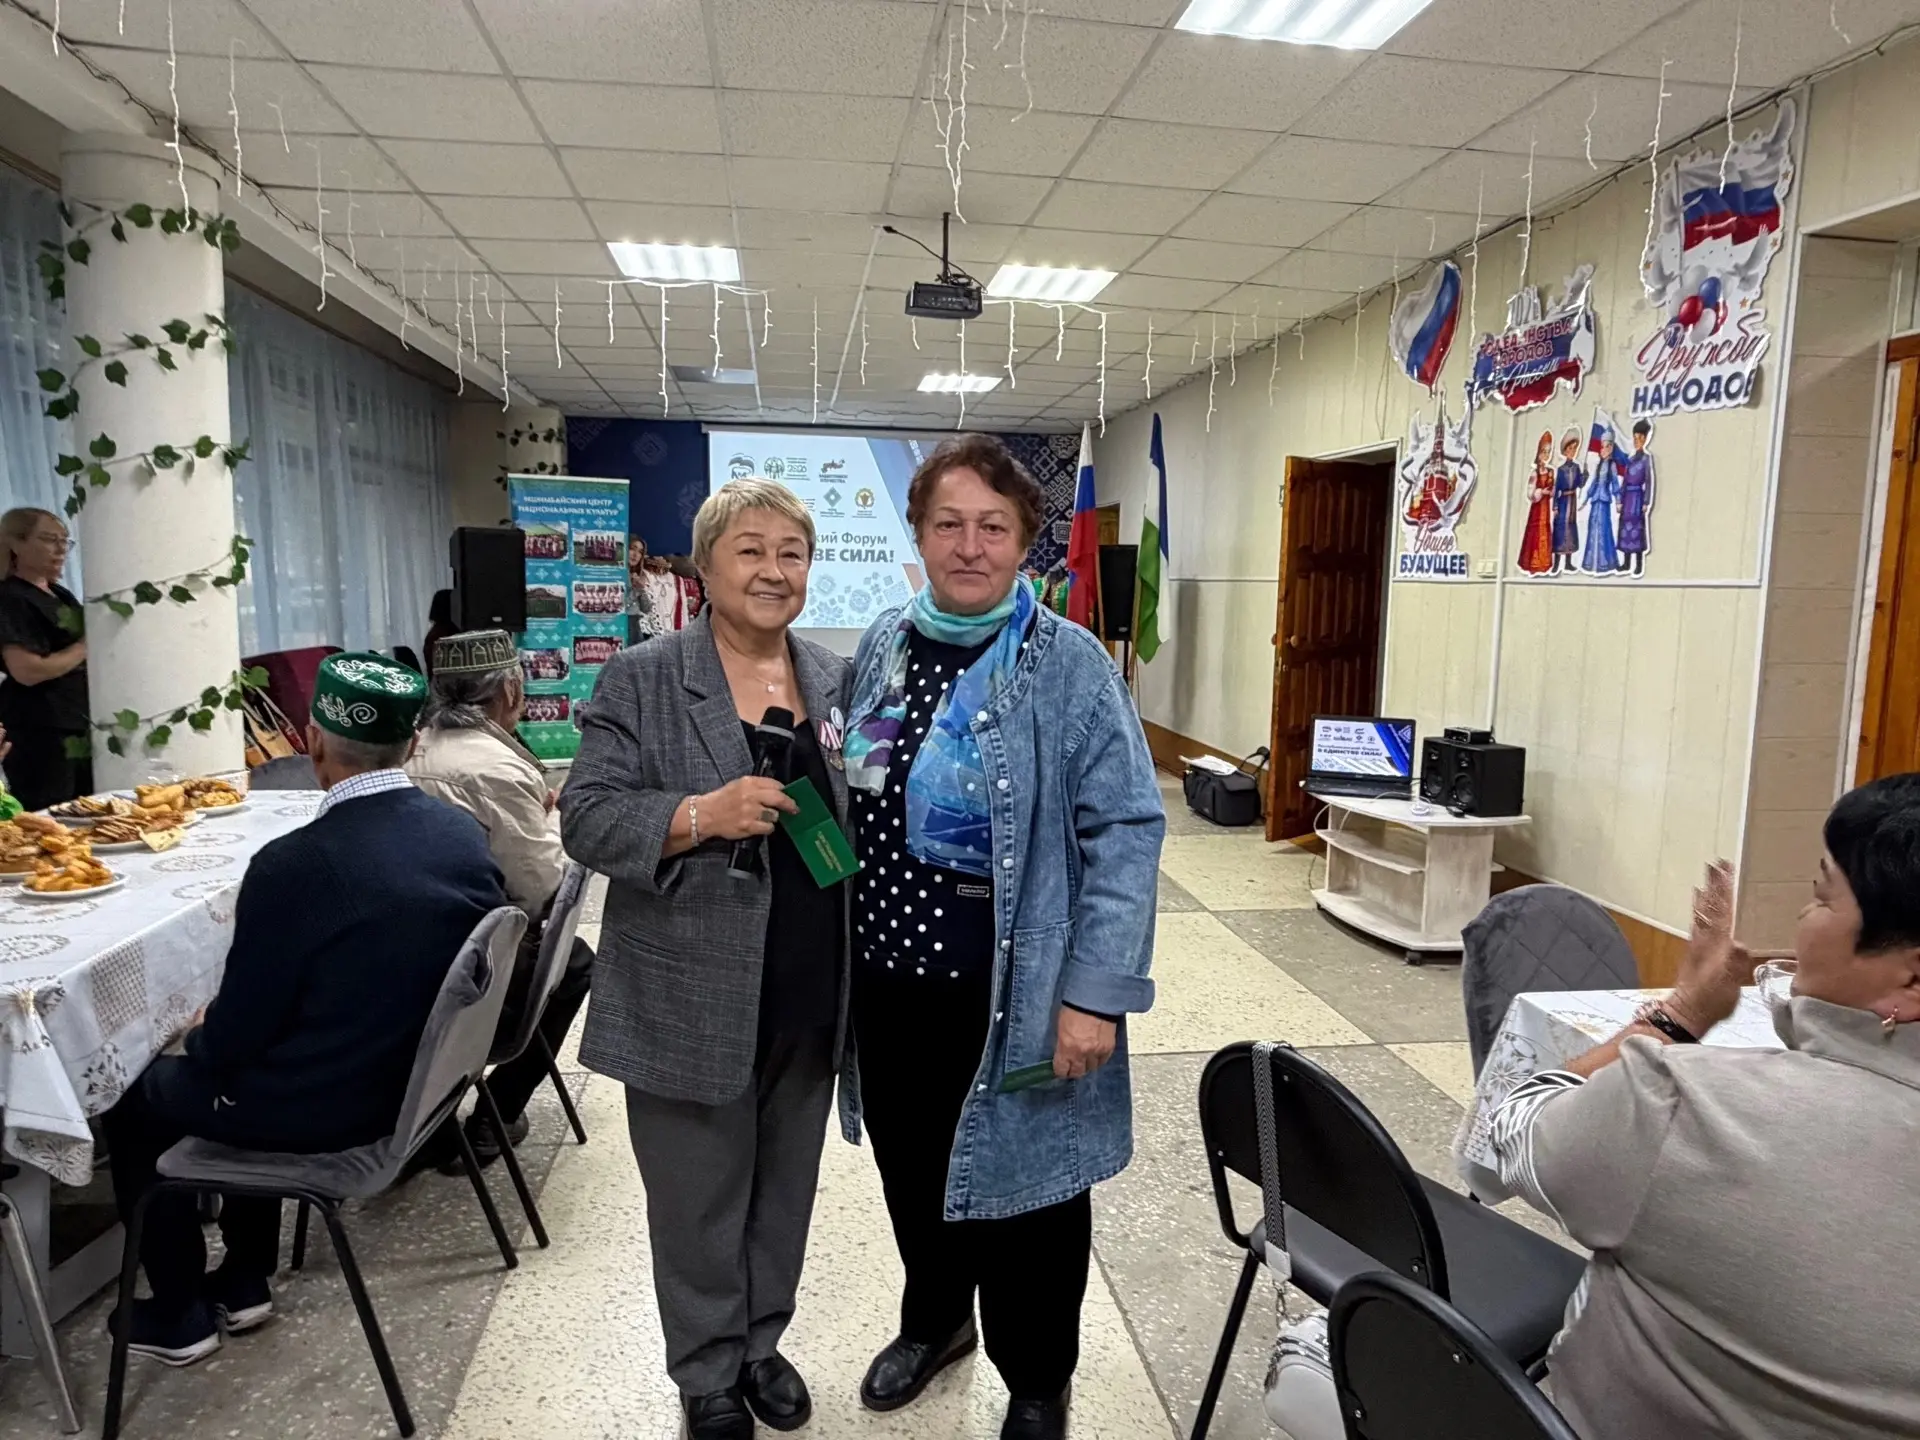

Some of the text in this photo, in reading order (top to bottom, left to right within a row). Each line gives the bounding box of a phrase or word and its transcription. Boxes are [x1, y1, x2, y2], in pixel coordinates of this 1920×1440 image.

[841, 532, 888, 547] Форум
[839, 549, 895, 563] СИЛА!
[1400, 554, 1466, 576] БУДУЩЕЕ
